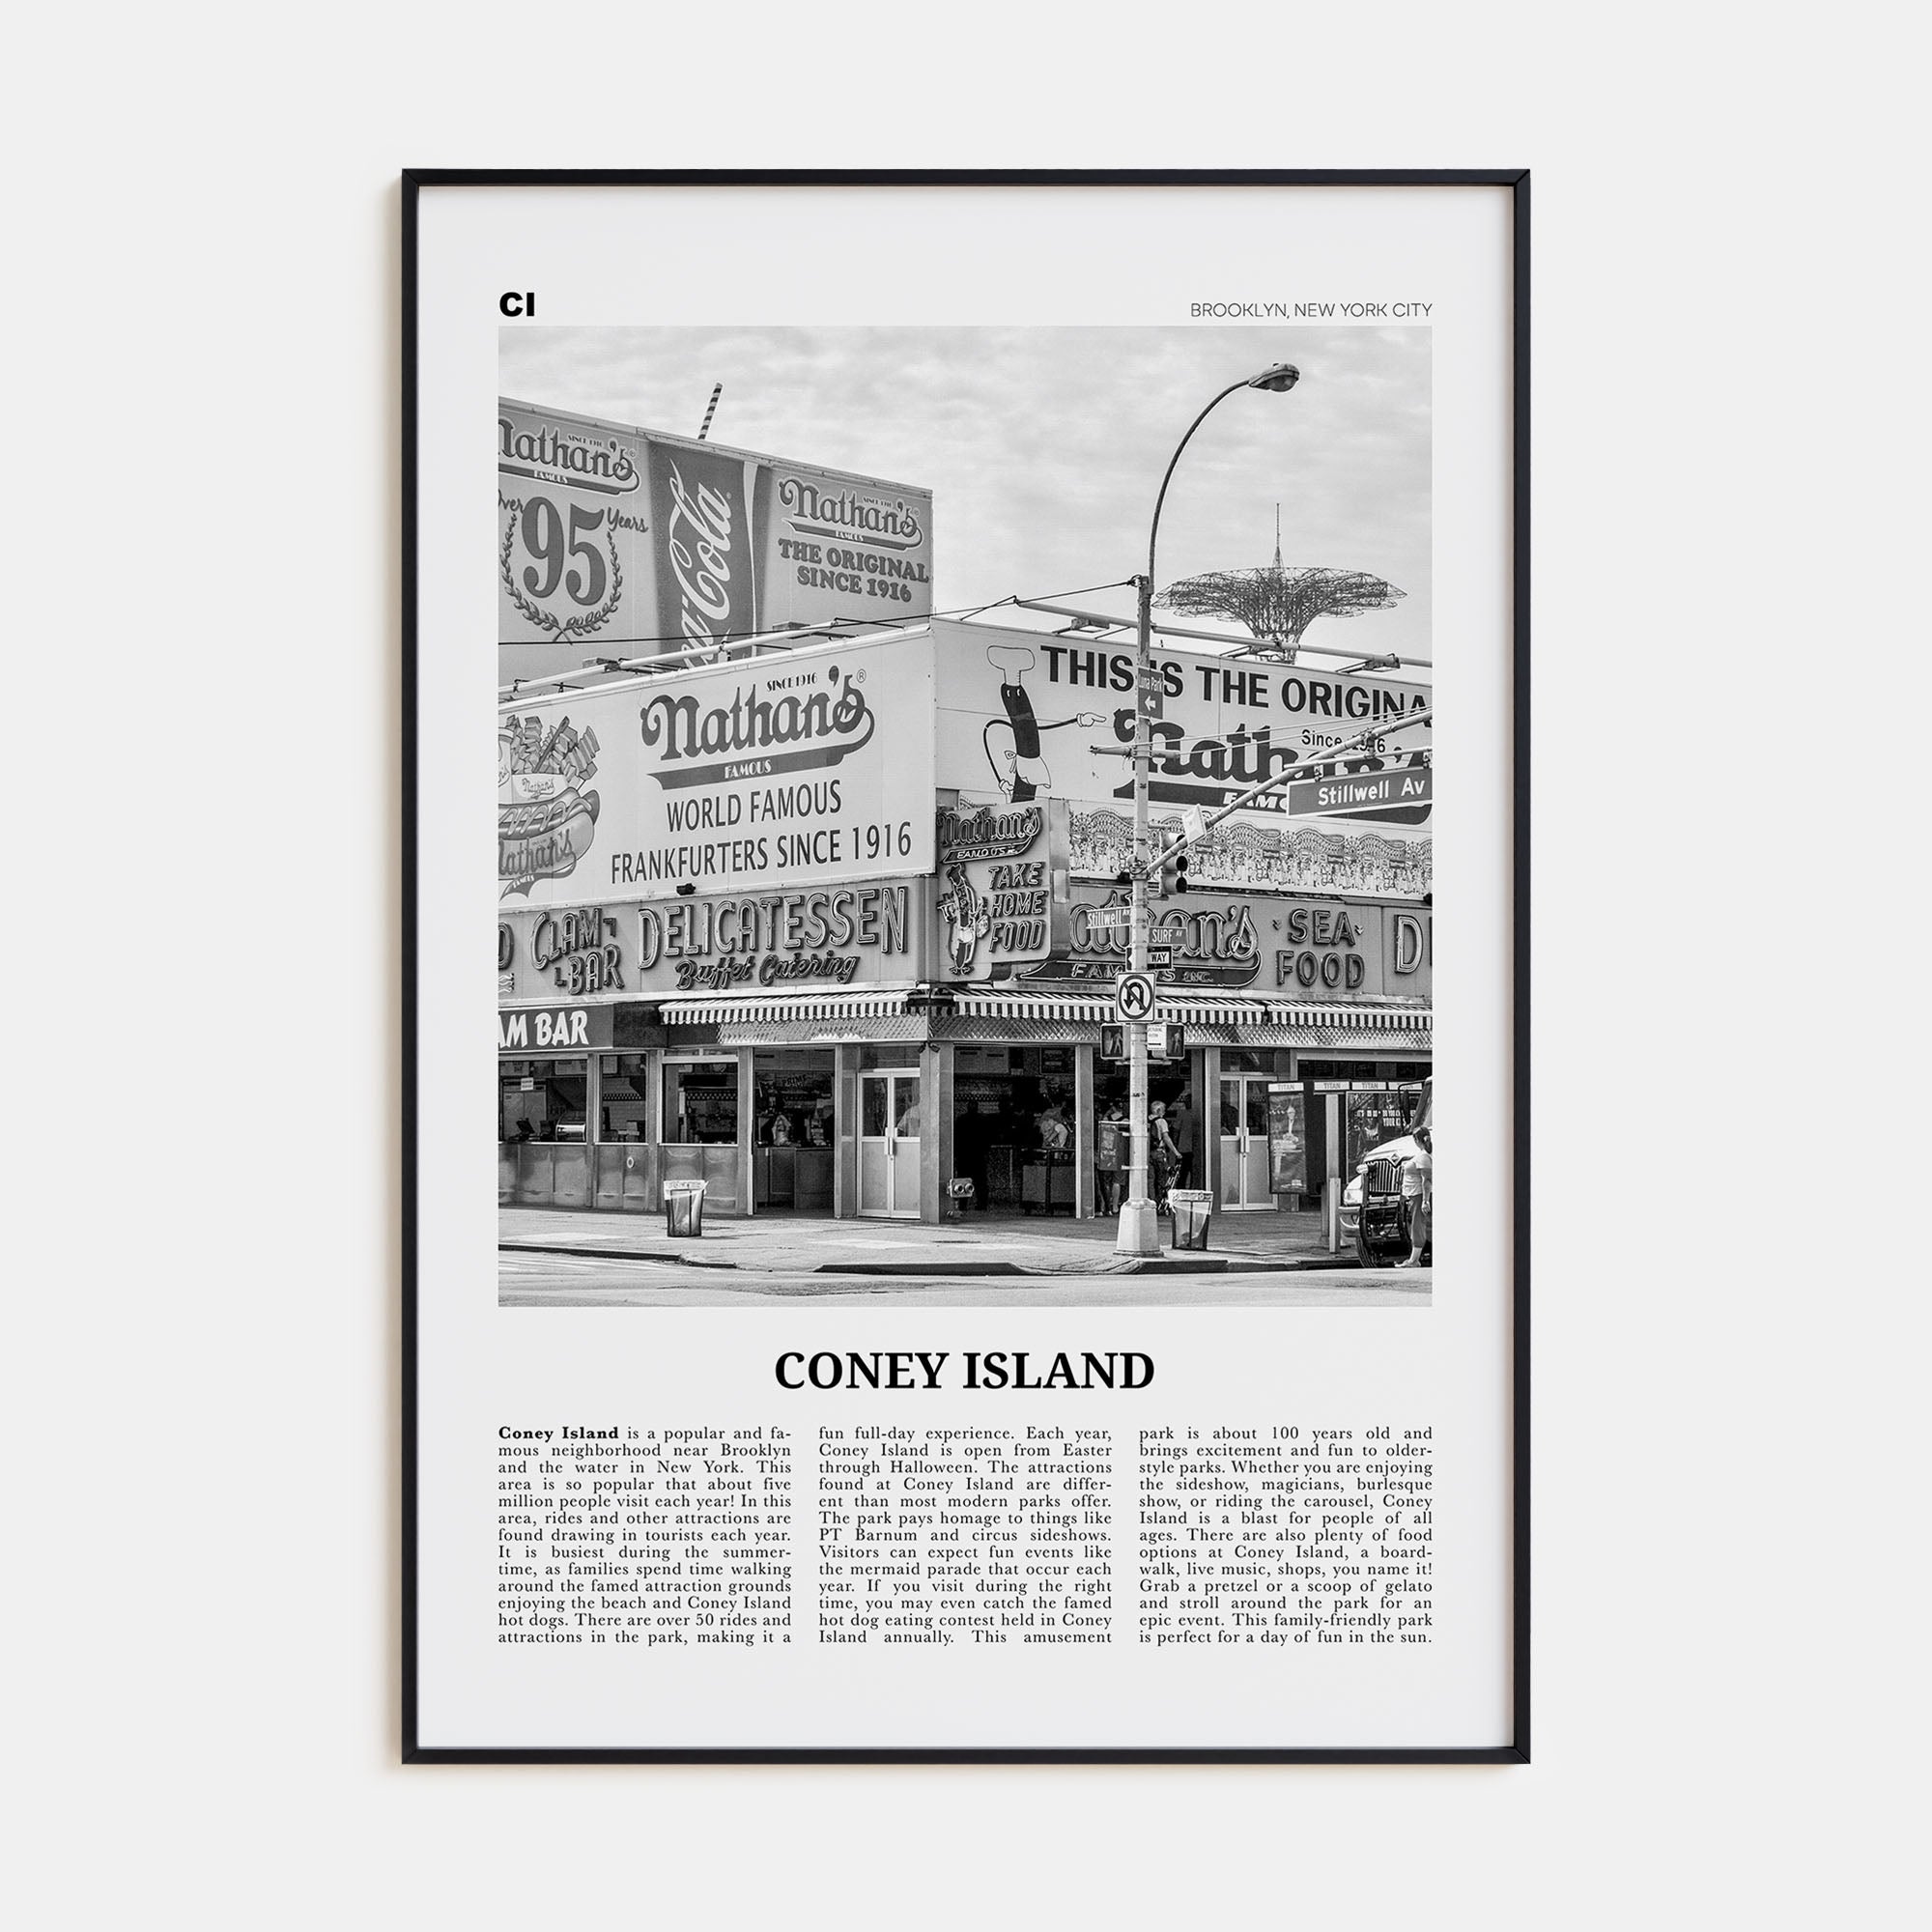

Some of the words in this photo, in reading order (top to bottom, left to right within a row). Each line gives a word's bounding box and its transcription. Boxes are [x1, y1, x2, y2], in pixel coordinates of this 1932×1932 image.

[499, 292, 535, 317] CI
[1191, 302, 1290, 320] BROOKLYN,
[1294, 302, 1336, 318] NEW
[1340, 302, 1388, 318] YORK
[1392, 302, 1434, 318] CITY
[498, 489, 524, 515] ver
[778, 478, 919, 538] Nathan's
[608, 506, 649, 533] Years
[521, 497, 607, 606] 95
[778, 537, 822, 564] THE
[827, 547, 929, 583] ORIGINAL
[797, 565, 863, 594] SINCE
[867, 578, 912, 603] 1916
[767, 676, 795, 692] SINCE
[796, 672, 818, 688] 1916
[1040, 645, 1135, 692] THIS
[1149, 659, 1183, 697] S
[1195, 666, 1269, 709] THE
[639, 666, 867, 761] Nathan's
[1301, 728, 1343, 748] Since
[724, 758, 773, 780] FAMOUS
[1318, 780, 1390, 806] Stillwell
[1401, 777, 1426, 797] Av
[667, 793, 742, 833] WORLD
[750, 779, 842, 823] FAMOUS
[936, 806, 1042, 847] Nathan's
[611, 837, 769, 884] FRANKFURTERS
[777, 829, 841, 868] SINCE
[853, 821, 912, 860] 1916
[988, 861, 1046, 891] TAKE
[990, 891, 1050, 919] HOME
[1088, 909, 1122, 927] Stillwell
[531, 908, 603, 971] CLAM
[638, 886, 909, 971] DELICATESSEN
[988, 920, 1046, 953] FOOD
[1152, 928, 1173, 943] SURF
[1288, 908, 1356, 947] SEA
[1151, 952, 1167, 962] WAY
[1394, 914, 1433, 975] D
[567, 943, 625, 996] BAR
[674, 954, 755, 990] Buffet
[758, 950, 861, 986] Catering
[1071, 963, 1177, 982] FAMS
[1276, 950, 1365, 988] FOOD
[534, 1009, 589, 1047] BAR
[775, 1351, 951, 1390] CONEY
[962, 1351, 1155, 1390] ISLAND
[497, 1425, 554, 1443] Coney
[561, 1426, 619, 1440] Island
[627, 1426, 639, 1439] is
[647, 1430, 656, 1439] a
[664, 1426, 725, 1444] popular
[733, 1426, 762, 1439] and
[770, 1426, 791, 1439] fa-
[818, 1426, 844, 1440] fun
[855, 1426, 916, 1444] full-day
[925, 1426, 1014, 1444] experience.
[1026, 1426, 1065, 1439] Each
[1074, 1430, 1112, 1444] year,
[1139, 1426, 1175, 1443] park
[1187, 1426, 1200, 1439] is
[1212, 1426, 1257, 1440] about
[1272, 1426, 1299, 1439] 100
[1312, 1430, 1353, 1443] years
[1365, 1426, 1390, 1440] old
[1404, 1426, 1433, 1440] and
[498, 1493, 554, 1508] million
[559, 1493, 611, 1512] people
[616, 1493, 649, 1508] visit
[654, 1493, 691, 1508] each
[696, 1494, 734, 1512] year!
[741, 1493, 757, 1508] In
[763, 1493, 792, 1508] this
[818, 1496, 843, 1508] ent
[854, 1493, 889, 1508] than
[900, 1496, 937, 1508] most
[948, 1493, 1009, 1508] modern
[1019, 1493, 1061, 1512] parks
[1071, 1493, 1112, 1508] offer.
[1139, 1493, 1181, 1510] show,
[1189, 1497, 1208, 1508] or
[1215, 1493, 1264, 1512] riding
[1270, 1493, 1295, 1508] the
[1303, 1493, 1374, 1511] carousel,
[1382, 1493, 1433, 1512] Coney
[819, 1561, 843, 1576] the
[850, 1561, 921, 1576] mermaid
[927, 1561, 981, 1579] parade
[988, 1561, 1019, 1576] that
[1026, 1566, 1070, 1576] occur
[1076, 1561, 1112, 1576] each
[1139, 1561, 1180, 1578] walk,
[1186, 1561, 1214, 1576] live
[1221, 1561, 1271, 1578] music,
[1277, 1561, 1326, 1579] shops,
[1332, 1566, 1360, 1579] you
[1367, 1566, 1409, 1576] name
[1416, 1561, 1433, 1576] it!
[497, 1630, 582, 1643] attractions
[591, 1630, 606, 1643] in
[614, 1630, 639, 1643] the
[647, 1630, 689, 1647] park,
[696, 1630, 755, 1647] making
[763, 1630, 774, 1643] it
[782, 1634, 792, 1643] a
[819, 1630, 867, 1643] Island
[883, 1630, 954, 1647] annually.
[971, 1630, 1007, 1643] This
[1023, 1633, 1112, 1643] amusement
[1139, 1630, 1151, 1643] is
[1157, 1629, 1212, 1647] perfect
[1217, 1629, 1240, 1643] for
[1245, 1634, 1255, 1643] a
[1260, 1630, 1289, 1647] day
[1293, 1629, 1312, 1643] of
[1318, 1629, 1343, 1643] fun
[1349, 1630, 1364, 1643] in
[1370, 1630, 1395, 1643] the
[1400, 1634, 1432, 1643] sun.
